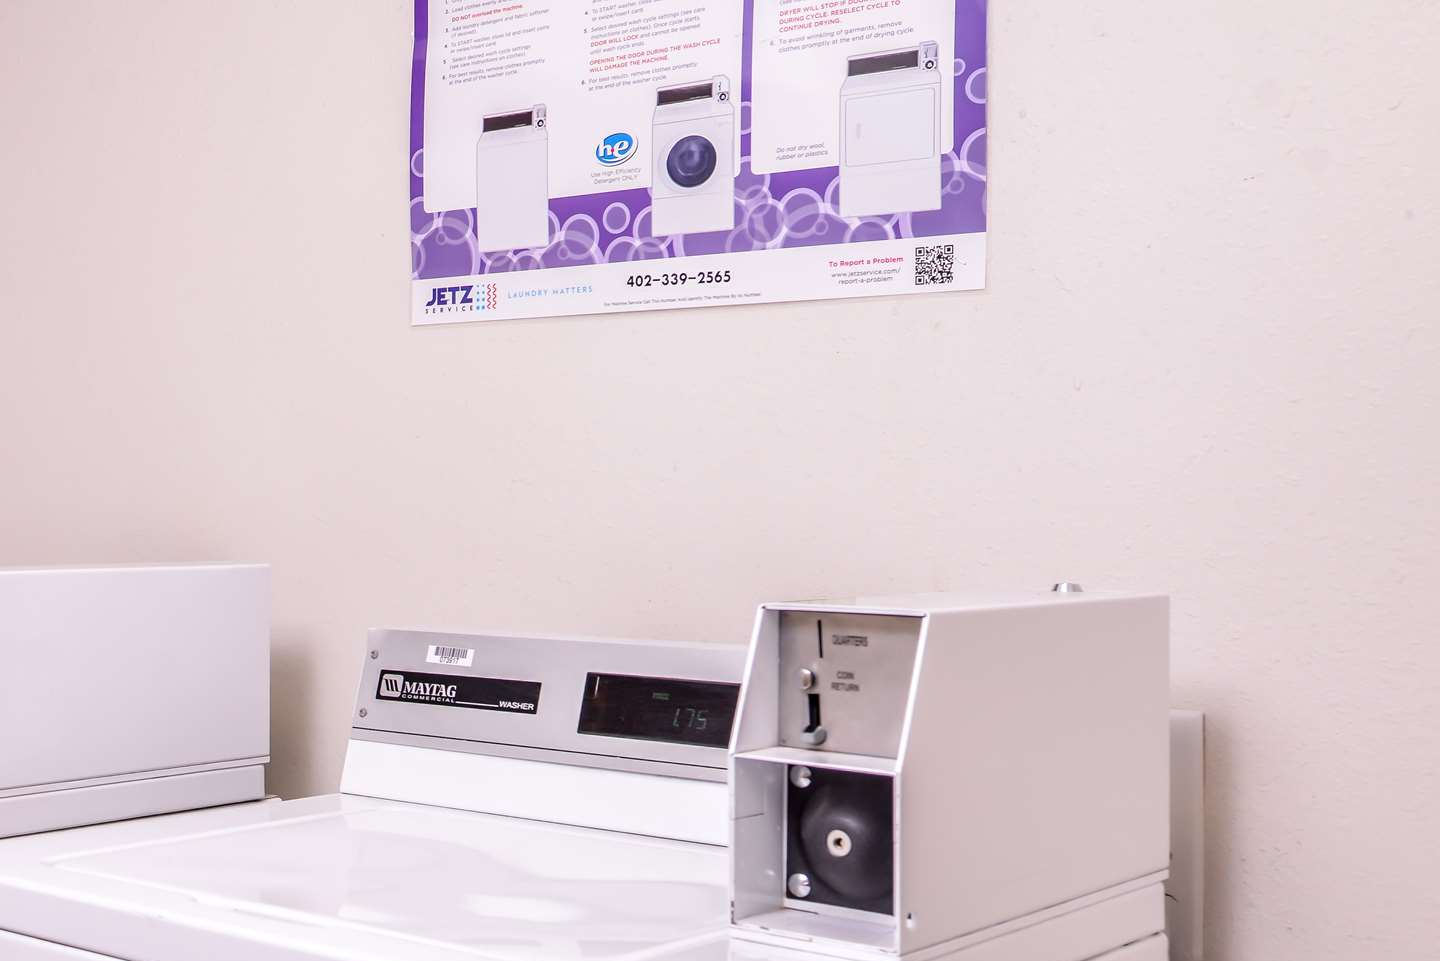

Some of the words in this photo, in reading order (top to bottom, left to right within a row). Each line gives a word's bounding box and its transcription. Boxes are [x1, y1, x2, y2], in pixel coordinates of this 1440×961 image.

[600, 5, 616, 13] START
[779, 8, 801, 17] DRYER
[779, 16, 804, 25] DURING
[830, 6, 864, 16] RESELECT
[866, 2, 889, 10] CYCLE
[779, 23, 812, 33] CONTINUE
[590, 57, 615, 66] OPENING
[646, 48, 668, 56] DURING
[702, 38, 720, 47] CYCLE
[604, 62, 628, 72] DAMAGE
[840, 259, 864, 267] Report
[627, 271, 731, 287] 402-339-2565
[838, 276, 893, 285] report-a-problem
[426, 285, 474, 306] JETZ
[508, 289, 548, 299] LAUNDRY
[552, 285, 593, 295] MATTERS
[425, 305, 473, 314] SERVICE
[832, 634, 869, 647] QUARTERS
[403, 681, 457, 697] MAYTAG
[831, 682, 860, 691] RETURN
[402, 694, 455, 703] COMMERCIAL
[498, 701, 535, 710] WASHER
